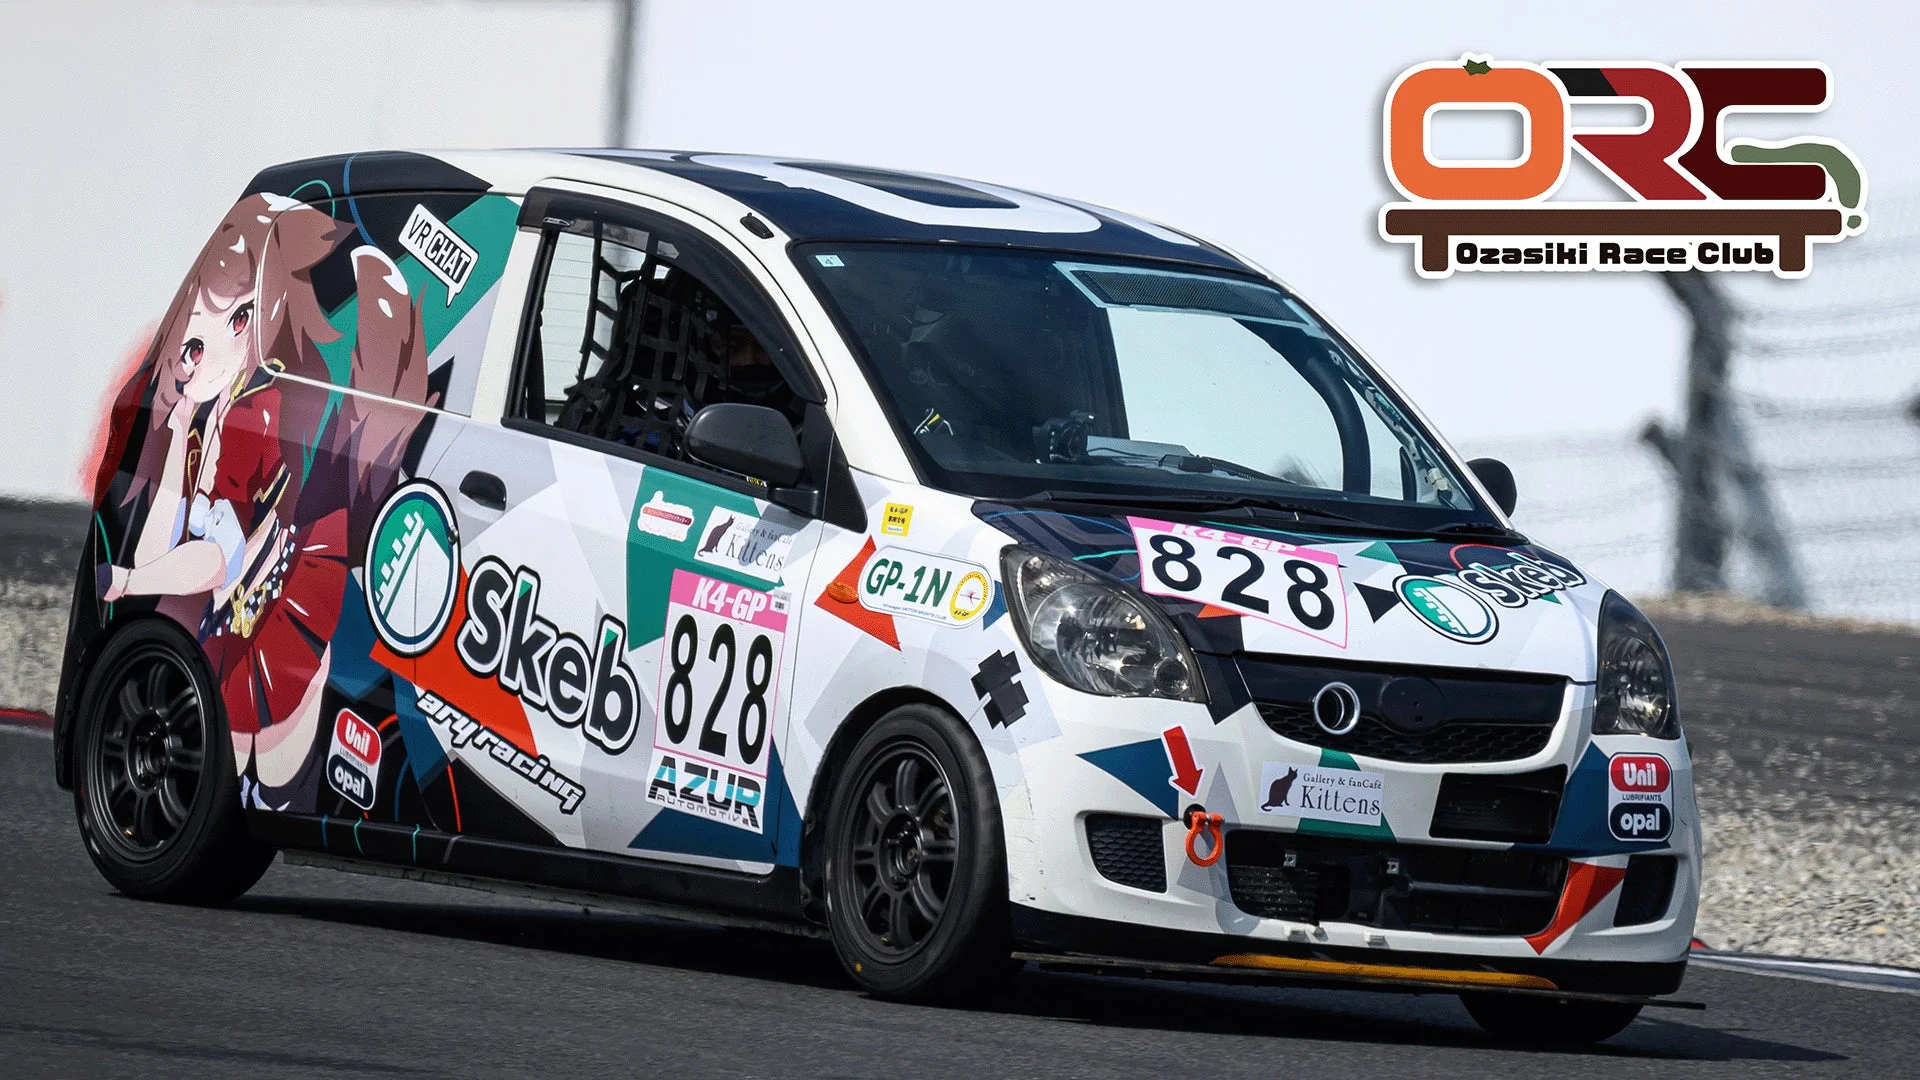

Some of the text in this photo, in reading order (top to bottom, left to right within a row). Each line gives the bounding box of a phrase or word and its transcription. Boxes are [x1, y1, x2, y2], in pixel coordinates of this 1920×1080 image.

[726, 533, 785, 572] Kittens
[1171, 523, 1297, 553] K4-GP
[691, 577, 767, 621] K4-GP
[866, 558, 952, 607] GP-1N
[1150, 534, 1335, 631] 828
[1459, 552, 1585, 606] Skeb
[458, 557, 640, 750] Skeb
[664, 613, 773, 764] 828
[345, 718, 371, 758] Unil
[335, 766, 366, 799] opal
[648, 755, 760, 829] AZUR
[1303, 773, 1335, 787] Gallery
[1338, 777, 1345, 785] &
[1623, 762, 1657, 786] Unil
[1300, 785, 1380, 815] Kittens
[1620, 808, 1660, 835] opal
